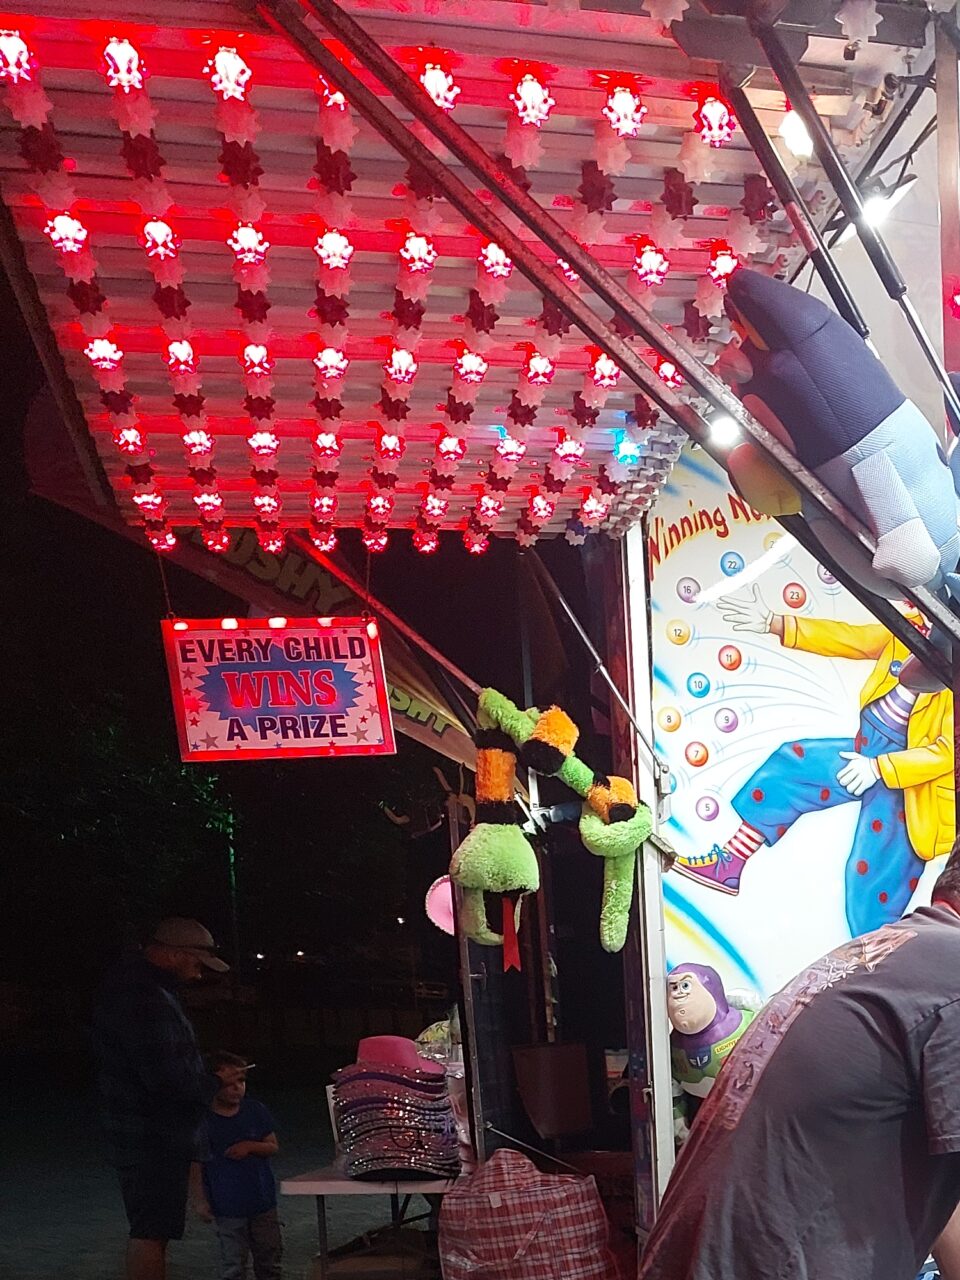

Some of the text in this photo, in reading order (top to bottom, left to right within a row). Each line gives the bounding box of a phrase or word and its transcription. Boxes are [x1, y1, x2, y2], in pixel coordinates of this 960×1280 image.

[728, 561, 737, 570] 22
[683, 585, 692, 594] 16
[790, 591, 800, 600] 23
[674, 628, 682, 637] 12
[178, 635, 366, 663] EVERY CHILD
[725, 653, 732, 662] 11
[221, 669, 338, 708] WINS
[694, 680, 702, 689] 10
[666, 715, 672, 724] 8
[724, 715, 730, 724] 9
[226, 714, 348, 741] A PRIZE
[694, 750, 699, 759] 7
